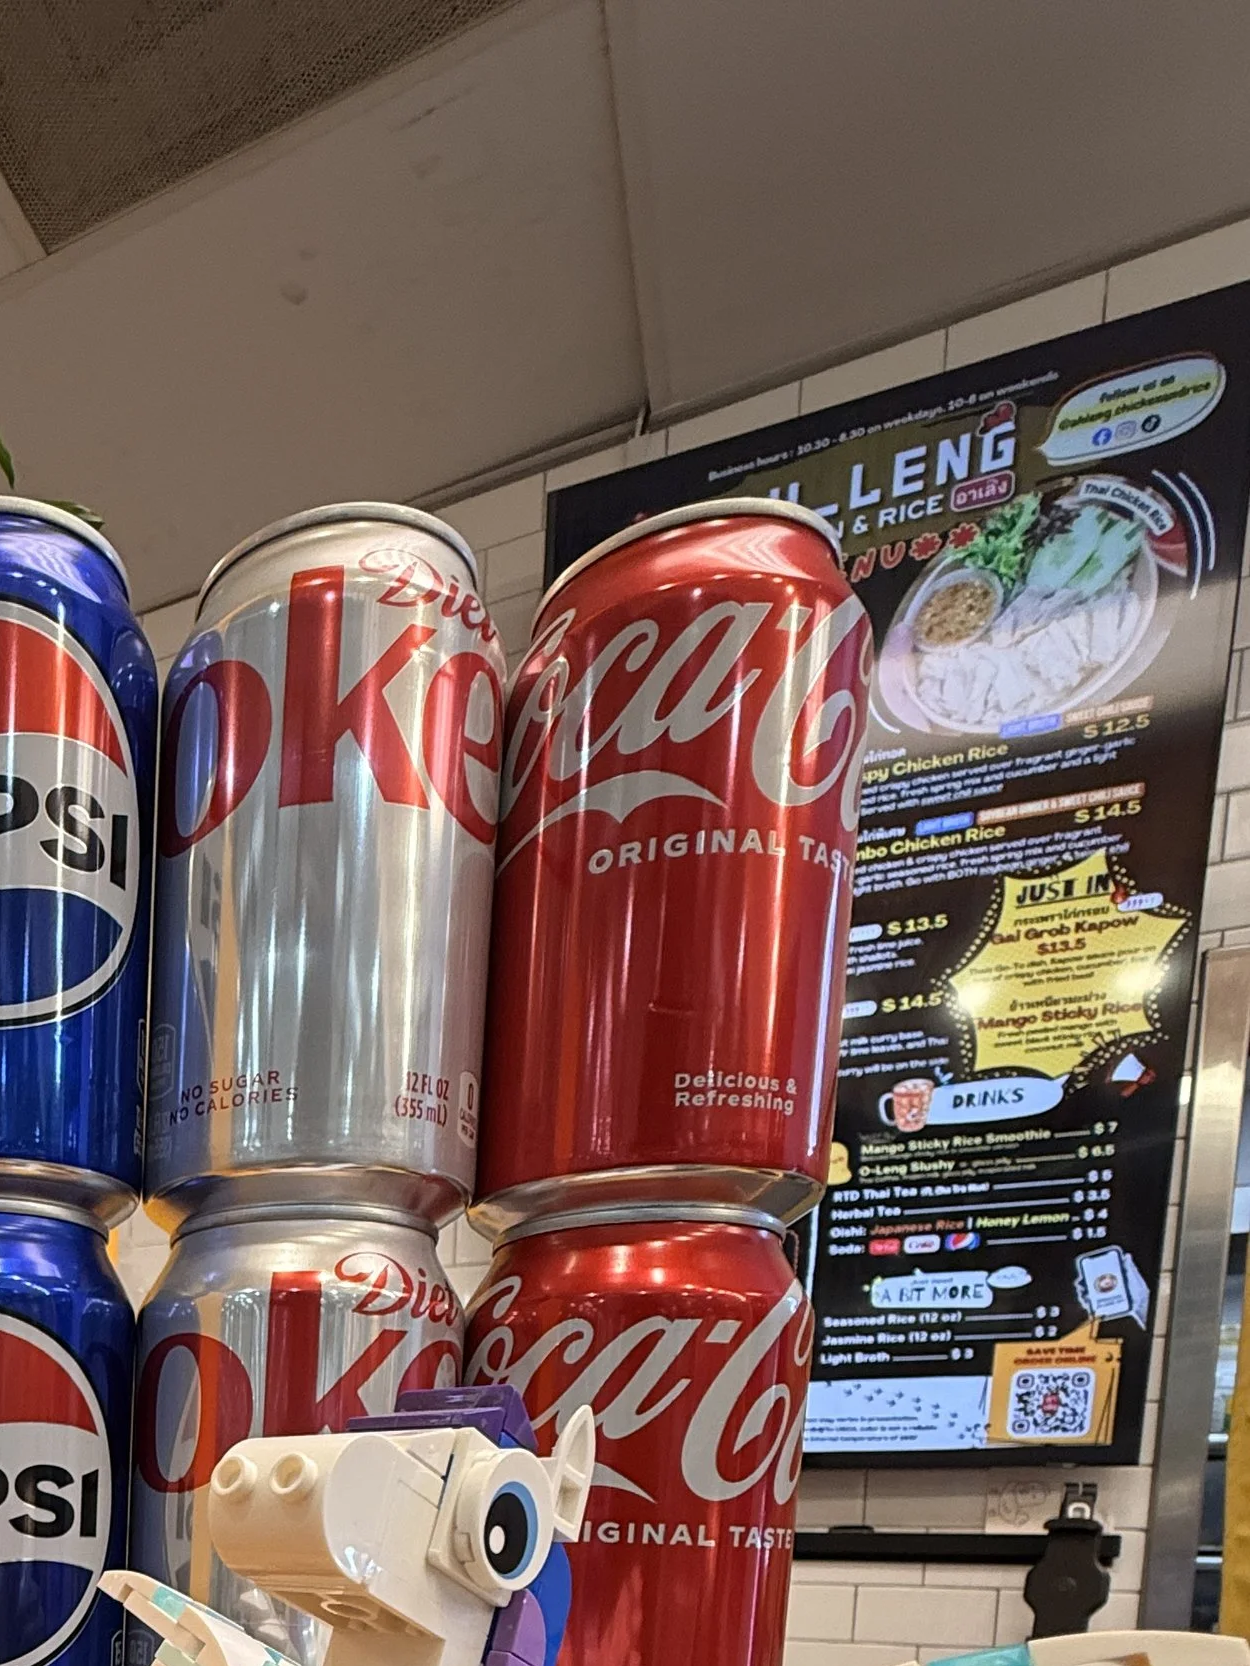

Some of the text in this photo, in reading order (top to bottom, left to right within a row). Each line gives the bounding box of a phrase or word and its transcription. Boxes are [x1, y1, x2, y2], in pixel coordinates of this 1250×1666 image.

[852, 493, 944, 535] & RICE
[1084, 483, 1168, 531] Thai Chicken Rice
[892, 744, 1009, 776] Chicken Rice
[1093, 800, 1143, 821] 14.5
[588, 828, 786, 874] ORIGINAL
[890, 834, 963, 855] Chicken
[965, 825, 1007, 843] Rice
[1016, 874, 1111, 905] JUST IN
[904, 914, 948, 934] 13.5
[1025, 924, 1071, 940] Grob
[1075, 915, 1139, 934] Kapow
[899, 990, 944, 1011] 14.5
[978, 1002, 1144, 1030] Mango Sticky Rice
[181, 1069, 282, 1105] NO SUGAR
[406, 1071, 450, 1101] 12 FL OZ
[674, 1071, 798, 1095] Delicious &
[169, 1086, 300, 1126] NO CALORIES
[395, 1094, 423, 1120] (355
[426, 1104, 448, 1127] mL)
[675, 1089, 794, 1116] Refreshing
[952, 1088, 1025, 1109] DRINKS
[860, 1143, 906, 1157] Mango
[908, 1138, 951, 1152] Sticky
[952, 1134, 983, 1147] Rice
[985, 1129, 1052, 1145] Smoothie
[1107, 1120, 1119, 1134] 7
[910, 1159, 956, 1173] Slushy
[833, 1190, 861, 1203] RTD
[862, 1187, 891, 1201] Thai
[893, 1186, 918, 1197] Tea
[831, 1207, 875, 1221] Herbal
[877, 1205, 902, 1217] Tea
[870, 1222, 933, 1236] Japanese
[936, 1219, 966, 1230] Rice
[975, 1215, 1021, 1229] Honey
[1022, 1212, 1071, 1226] Lemon
[334, 1251, 459, 1327] Diet
[880, 1284, 985, 1304] A BIT MORE
[823, 1315, 886, 1329] Seasoned
[888, 1312, 916, 1326] Rice
[822, 1333, 875, 1347] Jasmine
[877, 1331, 906, 1344] Rice
[820, 1352, 854, 1367] Light
[855, 1351, 891, 1364] Broth
[729, 1526, 793, 1549] TASTE
